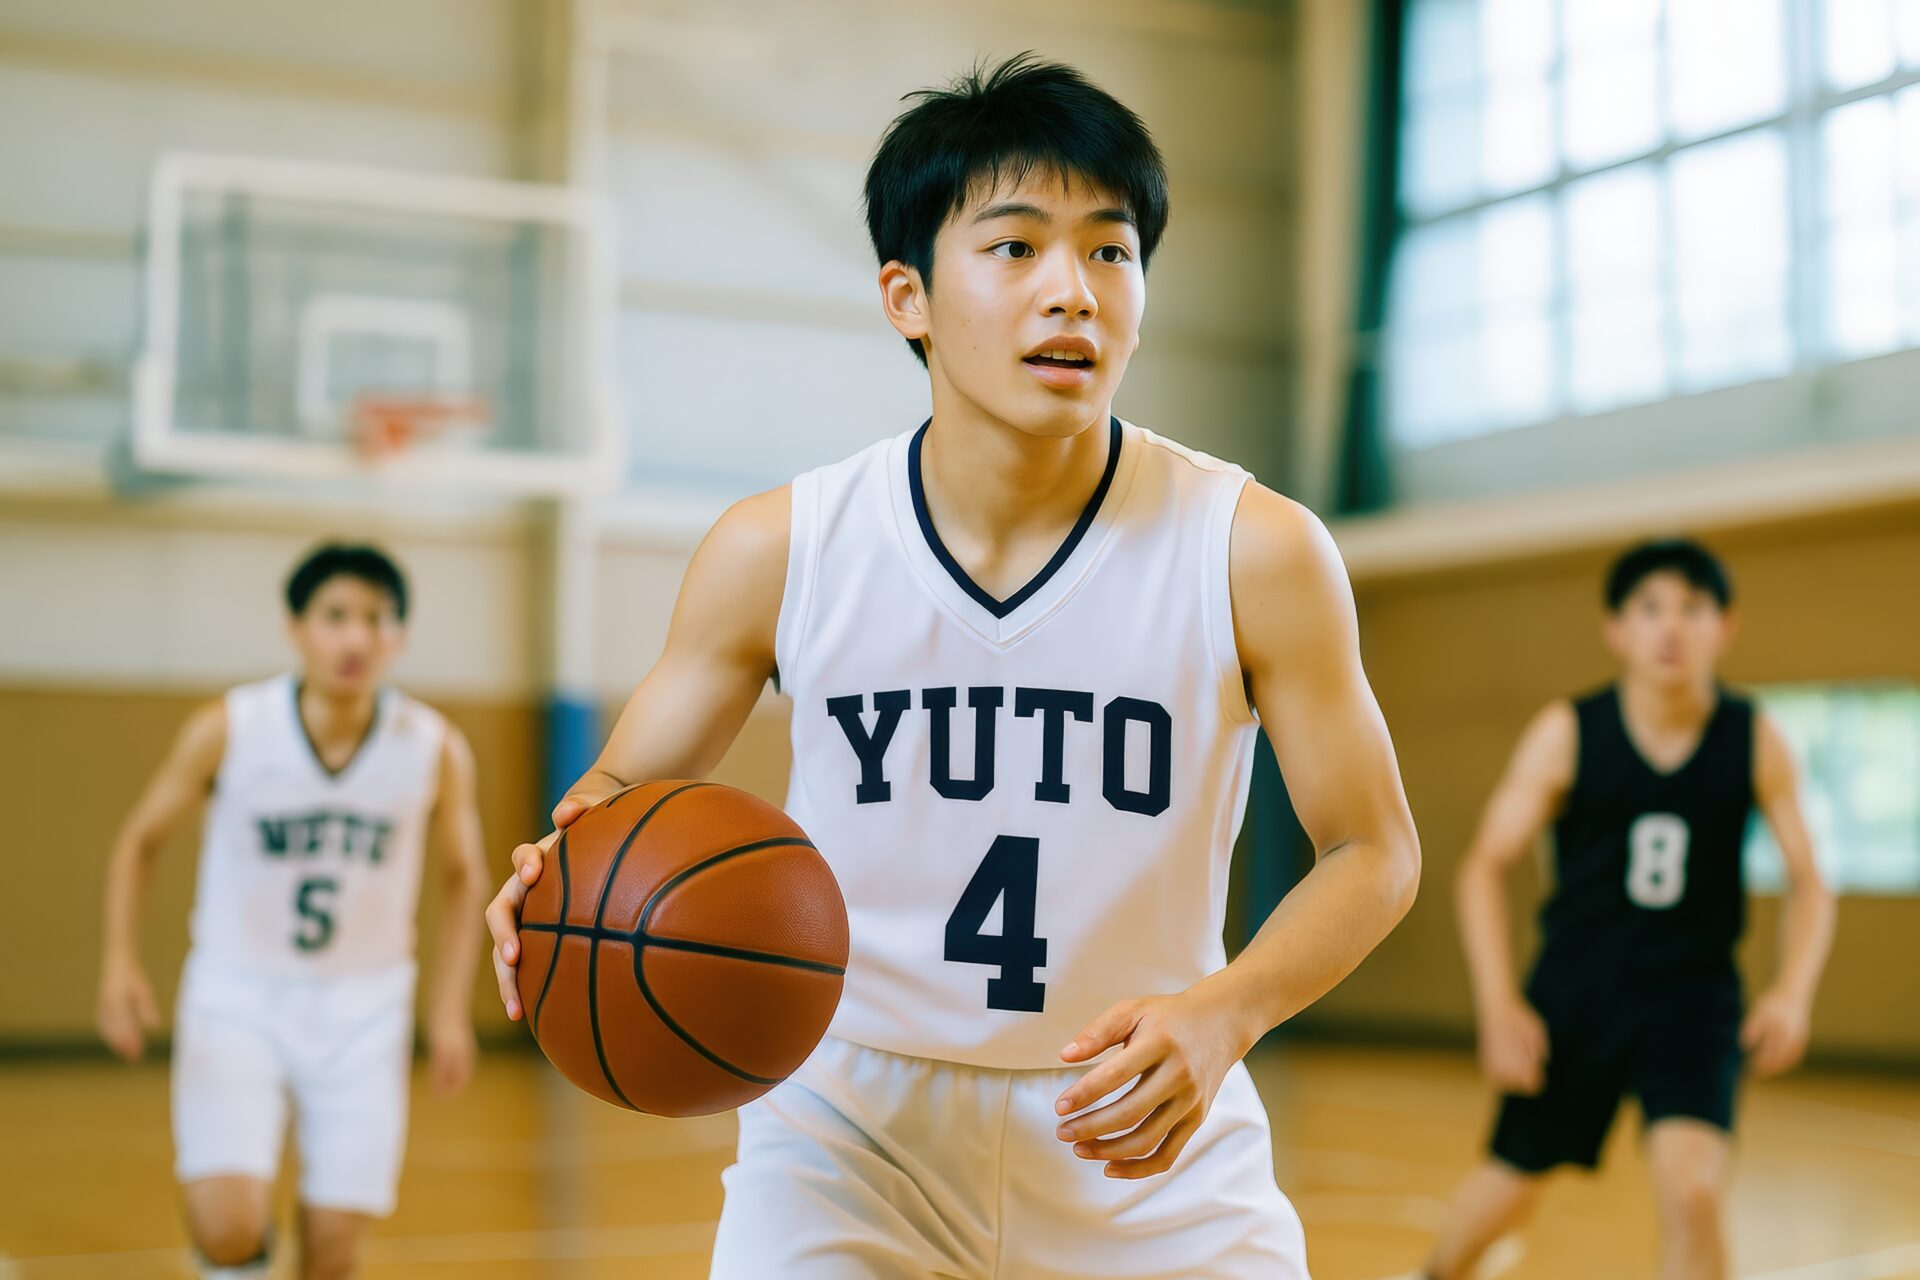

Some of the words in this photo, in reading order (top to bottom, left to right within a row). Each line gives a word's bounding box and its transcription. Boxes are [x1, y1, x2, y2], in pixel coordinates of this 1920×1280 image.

[826, 686, 1173, 818] YUTO
[293, 876, 339, 953] 5
[1627, 814, 1689, 907] 8
[943, 834, 1048, 1013] 4
